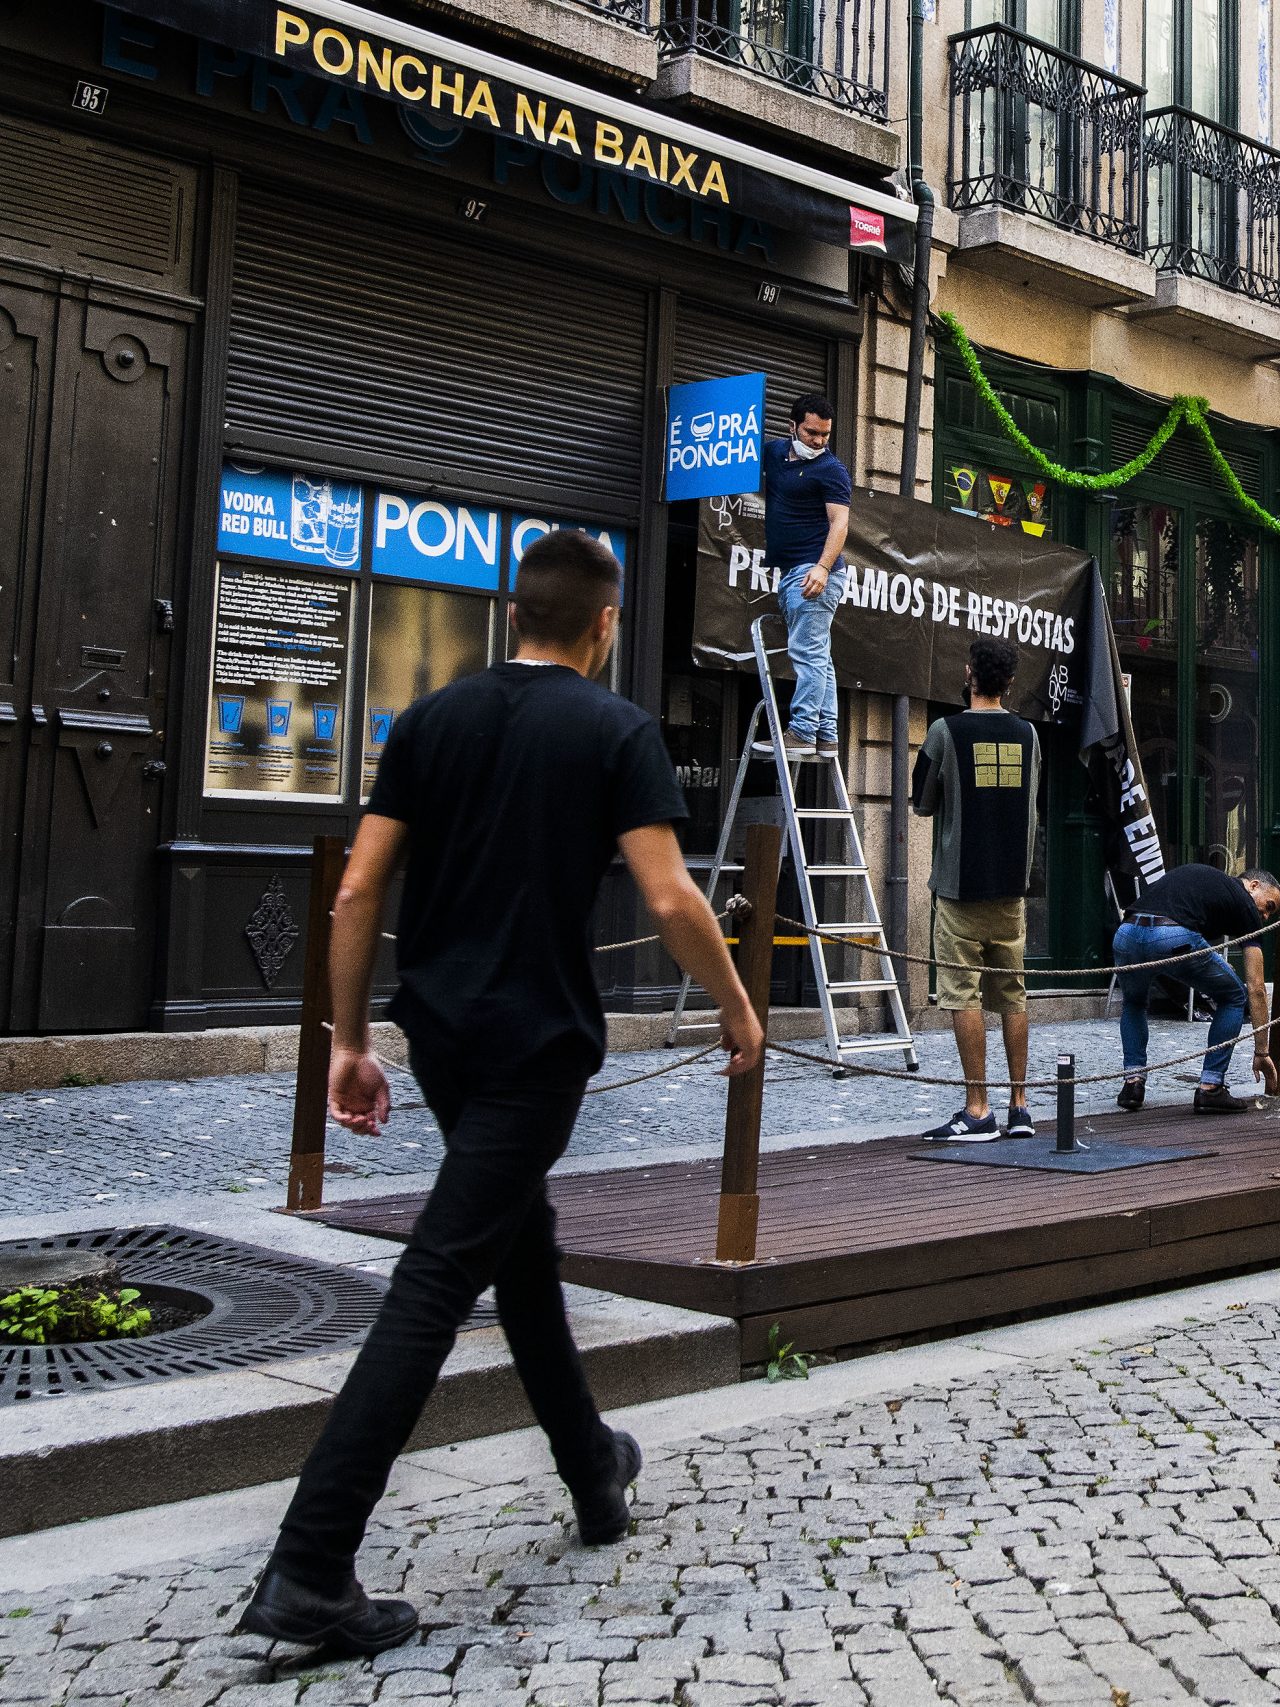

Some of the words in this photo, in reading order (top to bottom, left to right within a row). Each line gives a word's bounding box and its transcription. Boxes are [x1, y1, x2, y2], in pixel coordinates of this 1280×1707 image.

[81, 86, 100, 110] 95
[275, 9, 500, 128] PONCHA
[514, 92, 582, 155] NA
[594, 120, 730, 204] BAIXA
[464, 199, 487, 221] 97
[762, 284, 777, 303] 99
[670, 415, 683, 446] É
[718, 405, 759, 439] PRÁ
[669, 438, 758, 471] PONCHA
[223, 490, 275, 516] VODKA
[222, 513, 250, 535] RED
[253, 517, 288, 540] BULL
[932, 582, 960, 627] DE
[967, 592, 1075, 654] RESPOSTAS
